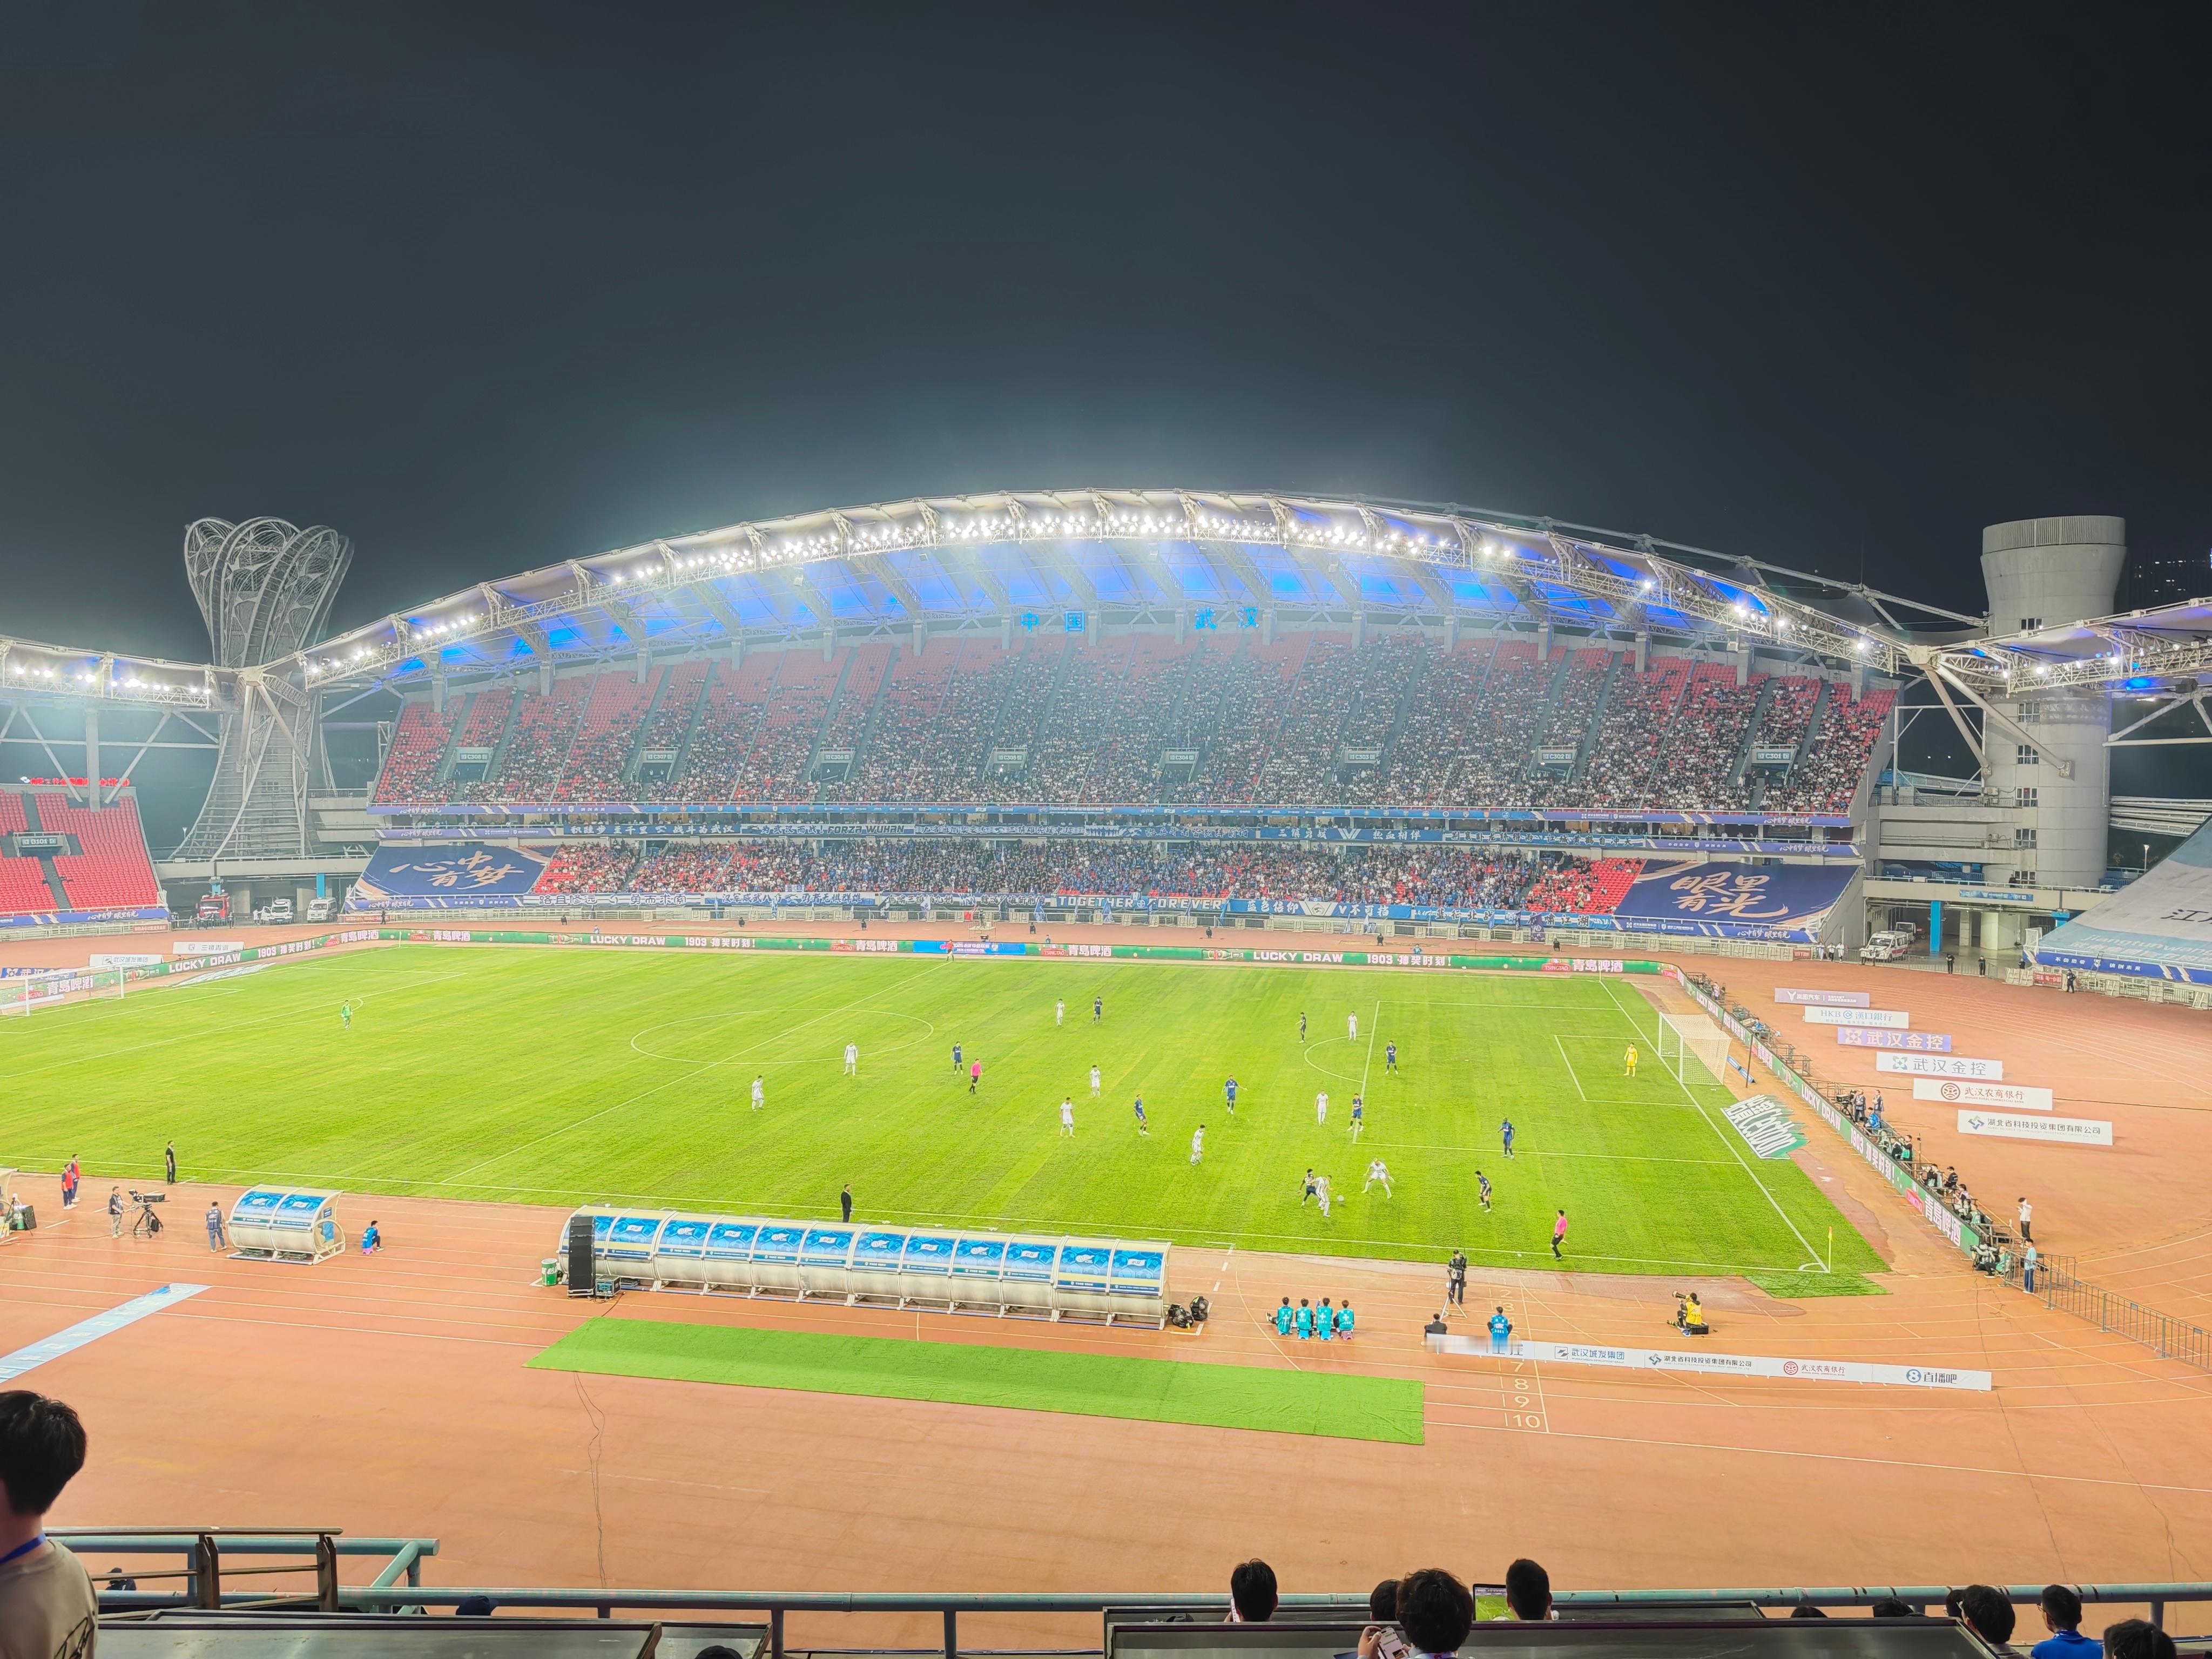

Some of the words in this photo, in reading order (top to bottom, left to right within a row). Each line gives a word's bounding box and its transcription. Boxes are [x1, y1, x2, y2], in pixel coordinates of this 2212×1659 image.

[1020, 609, 1085, 632] 中国
[1195, 605, 1260, 630] 武汉
[673, 825, 735, 835] 战斗为武汉
[761, 826, 824, 835] 为武汉而战！
[827, 826, 863, 834] FORZA
[866, 825, 905, 834] WUHAN
[1372, 831, 1421, 841] 热血相伴
[1547, 834, 1635, 847] 江城黄鹤自冲天
[389, 851, 493, 873] 心中
[427, 864, 525, 891] 有梦
[1670, 871, 1770, 896] 眼里
[539, 894, 598, 906] 路且修远
[630, 894, 687, 906] 勇而求索
[1058, 896, 1134, 908] TOGETHER
[1247, 899, 1299, 913] 蓝色信仰
[1672, 893, 1789, 918] 有光
[341, 929, 379, 943] 青岛啤酒
[433, 930, 471, 942] 青岛啤酒
[590, 935, 628, 945] LUCKY
[632, 936, 666, 946] DRAW
[684, 937, 707, 946] 1903
[258, 946, 277, 959] 1903
[855, 941, 898, 952] 青岛啤酒
[1068, 944, 1112, 957] 青岛啤酒
[1253, 950, 1298, 961] LUCKY
[1303, 952, 1344, 963] DRAW
[1367, 954, 1394, 965] 1903
[169, 957, 206, 974] LUCKY
[210, 953, 241, 967] DRAW
[1572, 960, 1623, 973] 青岛啤酒
[47, 976, 93, 995] 青岛啤酒
[1796, 993, 1820, 1001] 岚图汽车
[1820, 1009, 1841, 1019] HKB
[1855, 1010, 1893, 1022] 漢口銀行
[1866, 1031, 1944, 1050] 武汉金控
[1913, 1058, 1986, 1076] 武汉金控
[1964, 1086, 2025, 1100] 武汉农商银行
[1801, 1083, 1820, 1110] LUCKY
[1822, 1102, 1841, 1131] DRAW
[1987, 1117, 2100, 1135] 湖北省科技投资集团有限公司
[1850, 1127, 1864, 1155] 1903
[1906, 1191, 1923, 1213] TSINGTAO
[1925, 1194, 1961, 1248] 青岛啤酒
[1571, 1347, 1624, 1360] 武汉城发集团
[1510, 1361, 1525, 1372] 7
[1664, 1355, 1752, 1368] 湖北省科技投资集团有限公司
[1801, 1364, 1845, 1374] 武汉农商银行
[1514, 1378, 1529, 1390] 8
[1924, 1372, 1957, 1385] 直播吧
[1514, 1395, 1530, 1408] 9
[1513, 1414, 1541, 1428] 10
